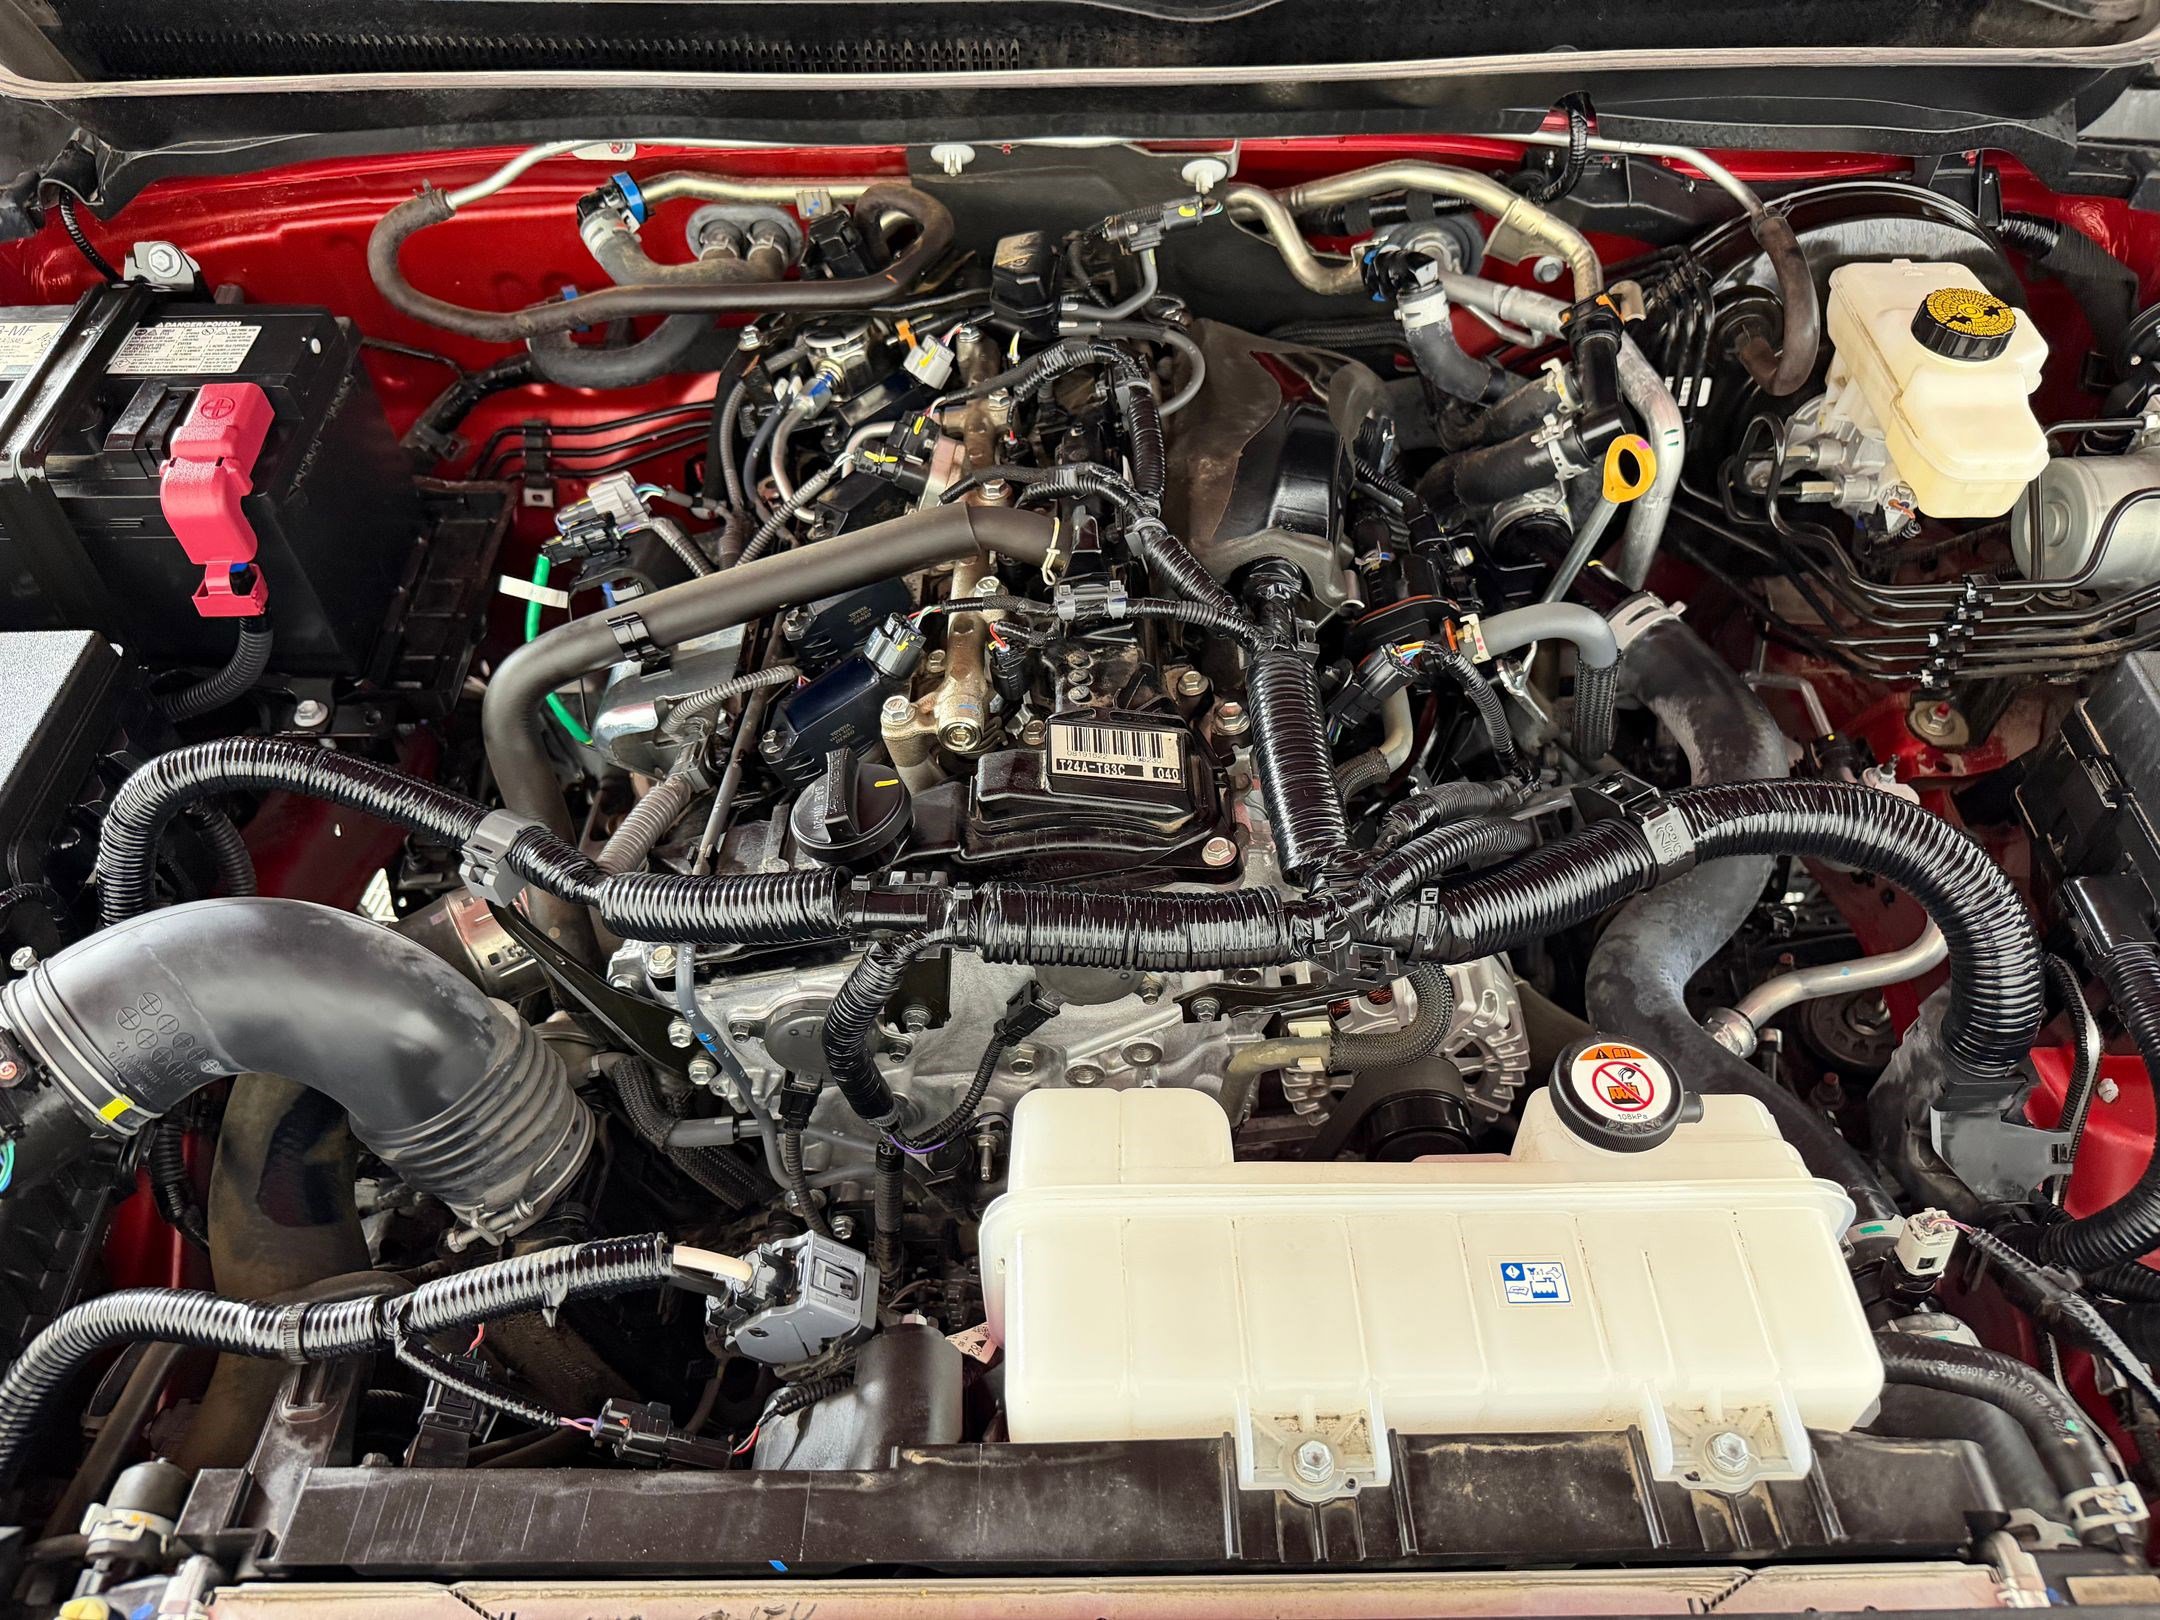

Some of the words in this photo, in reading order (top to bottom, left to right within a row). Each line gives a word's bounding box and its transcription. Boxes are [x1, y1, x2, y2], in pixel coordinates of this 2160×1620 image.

[1059, 759, 1126, 776] T24A-T83C
[1157, 768, 1179, 781] 040
[814, 785, 825, 802] SAE
[1605, 1116, 1664, 1135] DENSO
[1616, 1113, 1649, 1121] 108kPa
